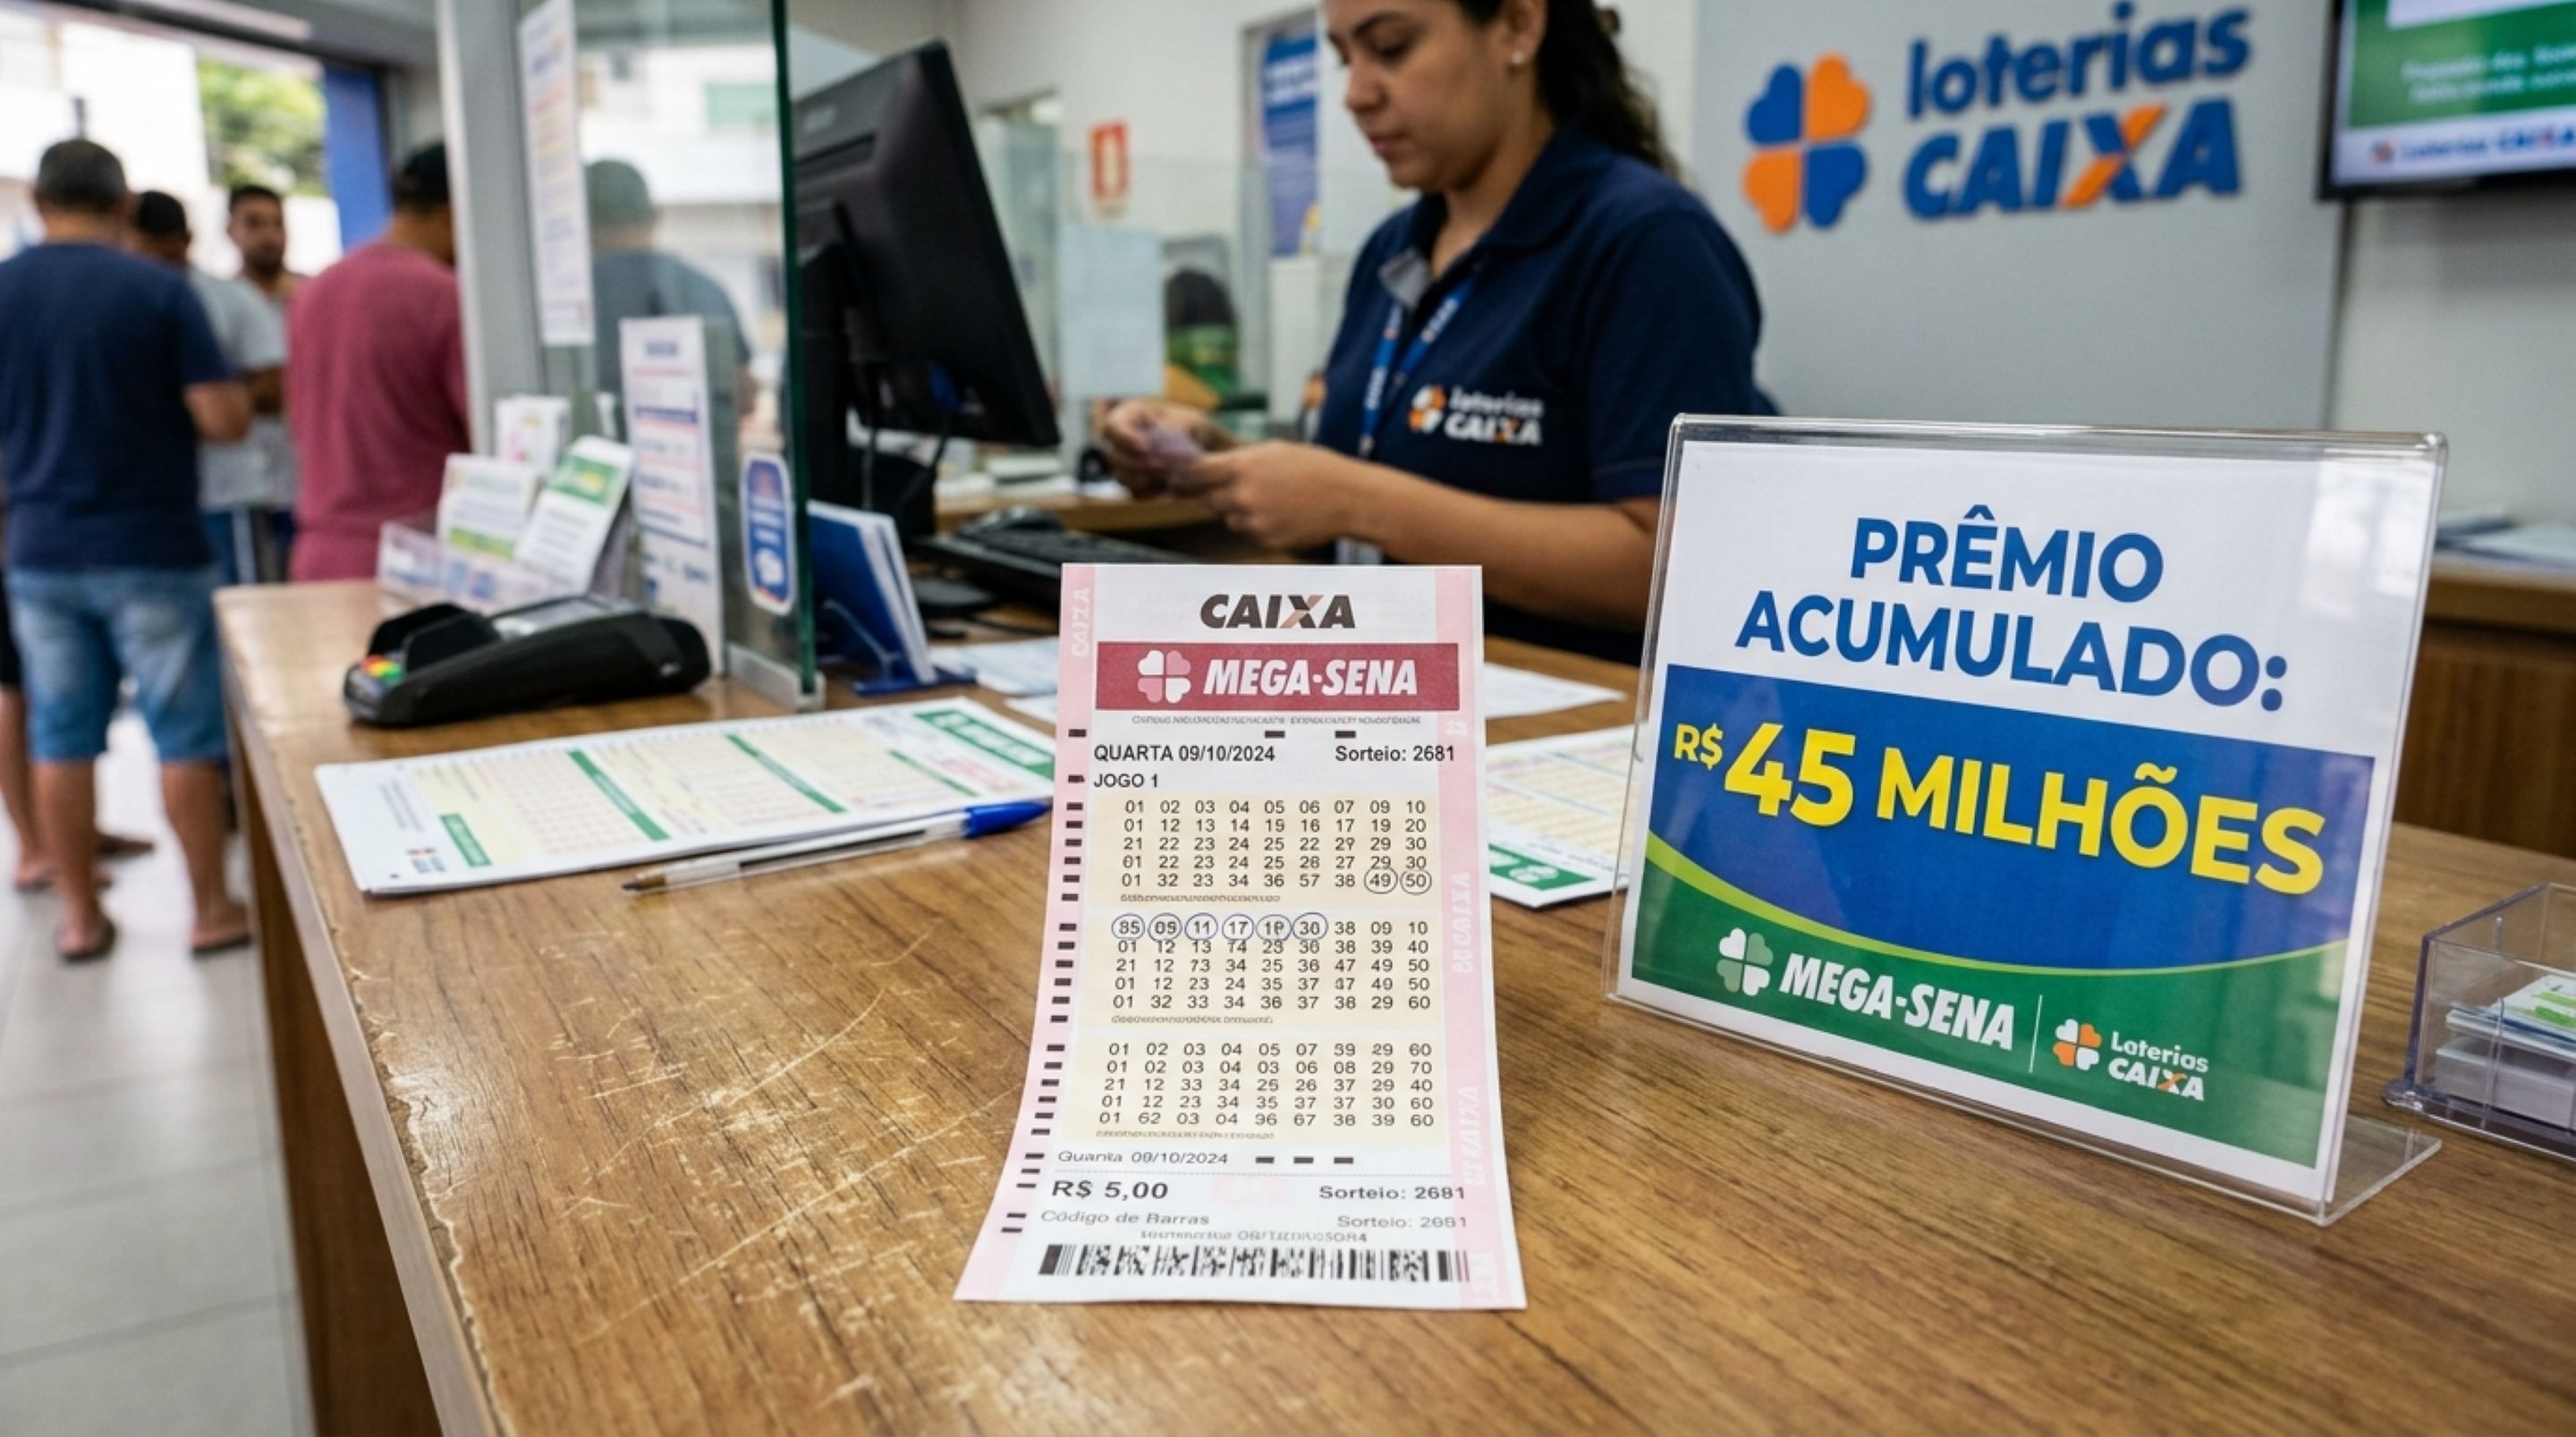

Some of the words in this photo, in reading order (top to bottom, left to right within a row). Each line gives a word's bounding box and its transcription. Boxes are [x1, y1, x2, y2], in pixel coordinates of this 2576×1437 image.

[1907, 1, 2251, 119] loterias
[1903, 97, 2241, 220] CAIXA
[1445, 412, 1541, 445] CAIXA
[1850, 504, 2164, 603] PRÊMIO
[1199, 594, 1355, 629] CAIXA
[1735, 591, 2286, 713] ACUMULADO:
[1094, 745, 1174, 762] QUARTA
[1178, 744, 1275, 762] 09/10/2024
[1335, 744, 1407, 762] Sorteio:
[1412, 745, 1455, 762] 2681
[1093, 773, 1145, 788] JOGO
[1150, 773, 1158, 788] 1
[1125, 800, 1143, 814] 01
[1160, 800, 1179, 814] 02
[1196, 800, 1215, 814] 03
[1230, 800, 1249, 814] 04
[1265, 800, 1284, 814] 05
[1300, 800, 1319, 814] 06
[1335, 800, 1353, 814] 07
[1370, 800, 1390, 814] 09
[1407, 800, 1426, 814] 10
[1674, 723, 1723, 770] R$
[1724, 723, 1856, 826] 45
[1877, 747, 2326, 895] MILHÕES
[1124, 819, 1142, 832] 01
[1162, 819, 1180, 832] 12
[1197, 819, 1215, 833] 13
[1232, 819, 1249, 832] 14
[1301, 819, 1319, 833] 16
[1336, 819, 1354, 833] 17
[1405, 819, 1426, 833] 20
[1124, 838, 1141, 850] 21
[1160, 838, 1179, 850] 22
[1194, 837, 1215, 850] 23
[1229, 838, 1249, 850] 24
[1265, 838, 1284, 850] 25
[1300, 838, 1319, 850] 22
[1370, 837, 1391, 850] 29
[1406, 837, 1426, 850] 30
[1159, 856, 1179, 868] 22
[1194, 855, 1215, 868] 23
[1229, 857, 1249, 868] 24
[1264, 857, 1284, 869] 25
[1336, 856, 1355, 869] 27
[1370, 857, 1391, 868] 29
[1406, 857, 1427, 868] 30
[1123, 874, 1140, 886] 01
[1158, 874, 1178, 886] 32
[1229, 874, 1249, 886] 34
[1265, 874, 1284, 887] 36
[1301, 874, 1319, 887] 57
[1406, 875, 1427, 887] 50
[1194, 922, 1209, 934] 11
[1229, 922, 1248, 934] 17
[1335, 922, 1355, 935] 38
[1371, 922, 1392, 935] 09
[1410, 922, 1428, 934] 10
[1118, 941, 1137, 953] 01
[1157, 941, 1175, 953] 12
[1192, 941, 1211, 953] 13
[1372, 940, 1393, 953] 39
[1408, 941, 1428, 953] 40
[1116, 959, 1134, 971] 21
[1155, 959, 1174, 972] 12
[1226, 959, 1246, 972] 34
[1335, 959, 1355, 971] 47
[1371, 959, 1393, 972] 49
[1409, 959, 1428, 972] 50
[1115, 977, 1134, 990] 01
[1155, 977, 1173, 990] 12
[1190, 977, 1209, 990] 23
[1225, 977, 1245, 990] 24
[1262, 977, 1282, 991] 35
[1299, 978, 1319, 991] 37
[1409, 977, 1429, 991] 50
[1114, 995, 1132, 1008] 01
[1151, 995, 1172, 1008] 32
[1188, 995, 1208, 1009] 33
[1224, 996, 1244, 1009] 34
[1299, 996, 1318, 1009] 37
[1372, 996, 1393, 1009] 29
[1409, 996, 1430, 1009] 60
[1779, 951, 2016, 1052] MEGA-SENA
[1109, 1044, 1128, 1055] 01
[1147, 1043, 1168, 1055] 02
[1184, 1044, 1206, 1055] 03
[1222, 1044, 1241, 1055] 04
[1259, 1044, 1280, 1056] 05
[1296, 1044, 1318, 1056] 07
[1410, 1044, 1431, 1056] 60
[1107, 1061, 1126, 1073] 01
[1145, 1061, 1165, 1073] 02
[1182, 1061, 1204, 1073] 03
[1220, 1061, 1241, 1073] 04
[1258, 1061, 1278, 1074] 03
[1296, 1061, 1318, 1074] 06
[1335, 1061, 1355, 1074] 08
[1411, 1061, 1432, 1074] 70
[1105, 1078, 1124, 1090] 21
[1145, 1078, 1164, 1090] 12
[1182, 1079, 1201, 1091] 33
[1220, 1079, 1240, 1091] 34
[1295, 1079, 1317, 1091] 26
[1335, 1079, 1355, 1092] 37
[1372, 1079, 1394, 1091] 29
[1411, 1079, 1432, 1092] 40
[2107, 1057, 2206, 1103] CAIXA
[1102, 1095, 1122, 1107] 01
[1181, 1095, 1201, 1107] 23
[1217, 1096, 1239, 1109] 34
[1257, 1096, 1278, 1109] 35
[1295, 1096, 1316, 1109] 37
[1335, 1096, 1355, 1109] 37
[1373, 1096, 1394, 1109] 30
[1411, 1097, 1433, 1109] 60
[1100, 1112, 1119, 1123] 01
[1177, 1112, 1199, 1124] 03
[1216, 1113, 1237, 1124] 04
[1373, 1114, 1394, 1126] 39
[1411, 1114, 1434, 1126] 60
[1052, 1179, 1093, 1198] R$
[1105, 1181, 1169, 1201] 5,00
[1319, 1186, 1406, 1199] Sorteio:
[1414, 1187, 1465, 1199] 2681
[1041, 1209, 1110, 1225] Código
[1115, 1212, 1140, 1223] de
[1146, 1213, 1210, 1225] Barras
